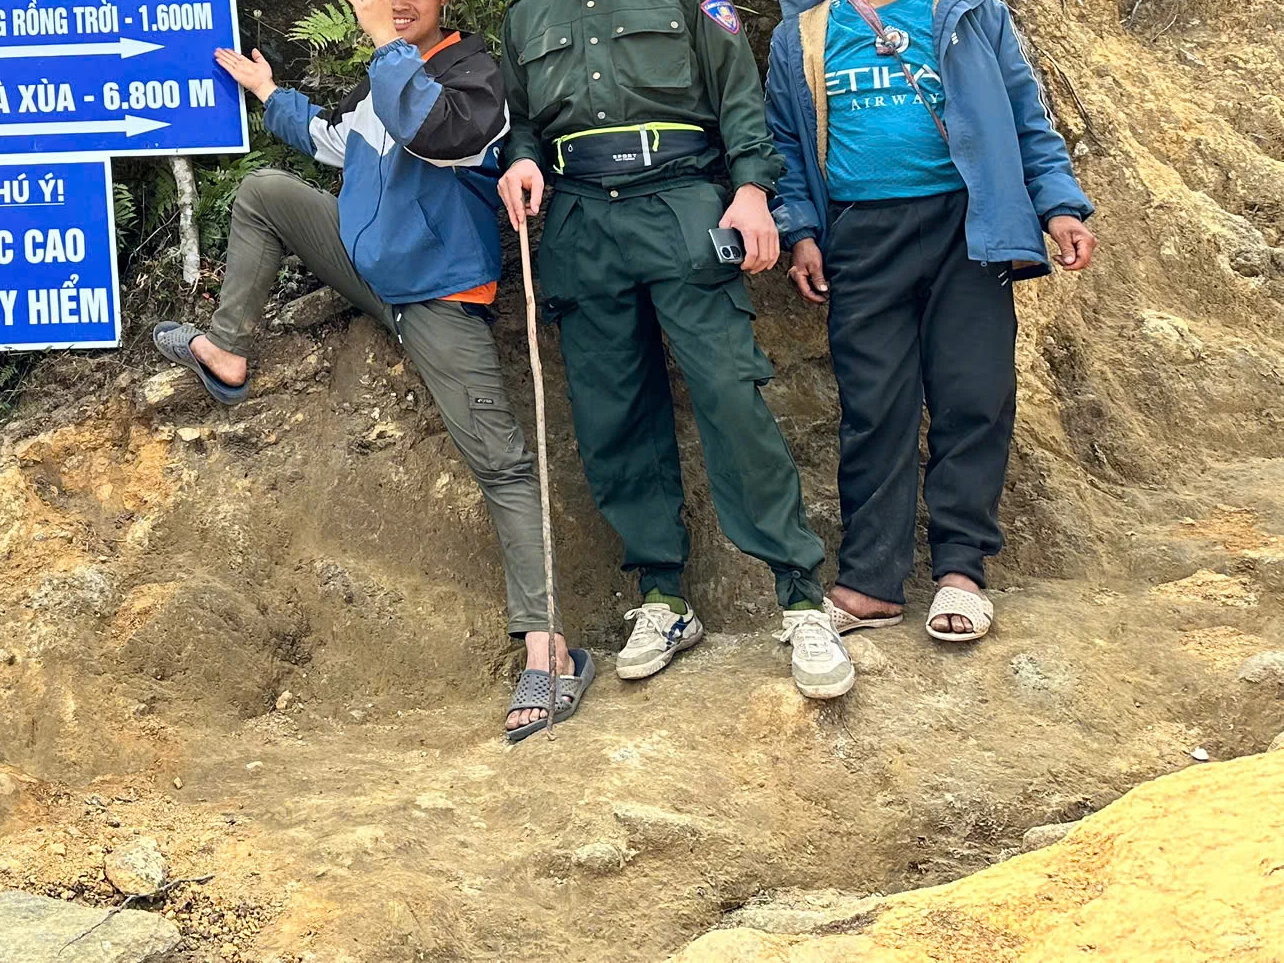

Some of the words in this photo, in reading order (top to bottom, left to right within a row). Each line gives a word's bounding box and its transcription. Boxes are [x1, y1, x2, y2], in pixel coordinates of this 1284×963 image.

[72, 0, 119, 34] TRỜI
[138, 2, 214, 32] 1.600M
[17, 78, 77, 113] XÙA
[103, 81, 181, 111] 6.800
[188, 78, 216, 108] M
[825, 63, 941, 95] ETIHA
[851, 93, 940, 111] AIRWAY
[38, 172, 65, 203] Ý!
[24, 227, 86, 264] CAO
[27, 273, 110, 325] HIỂM
